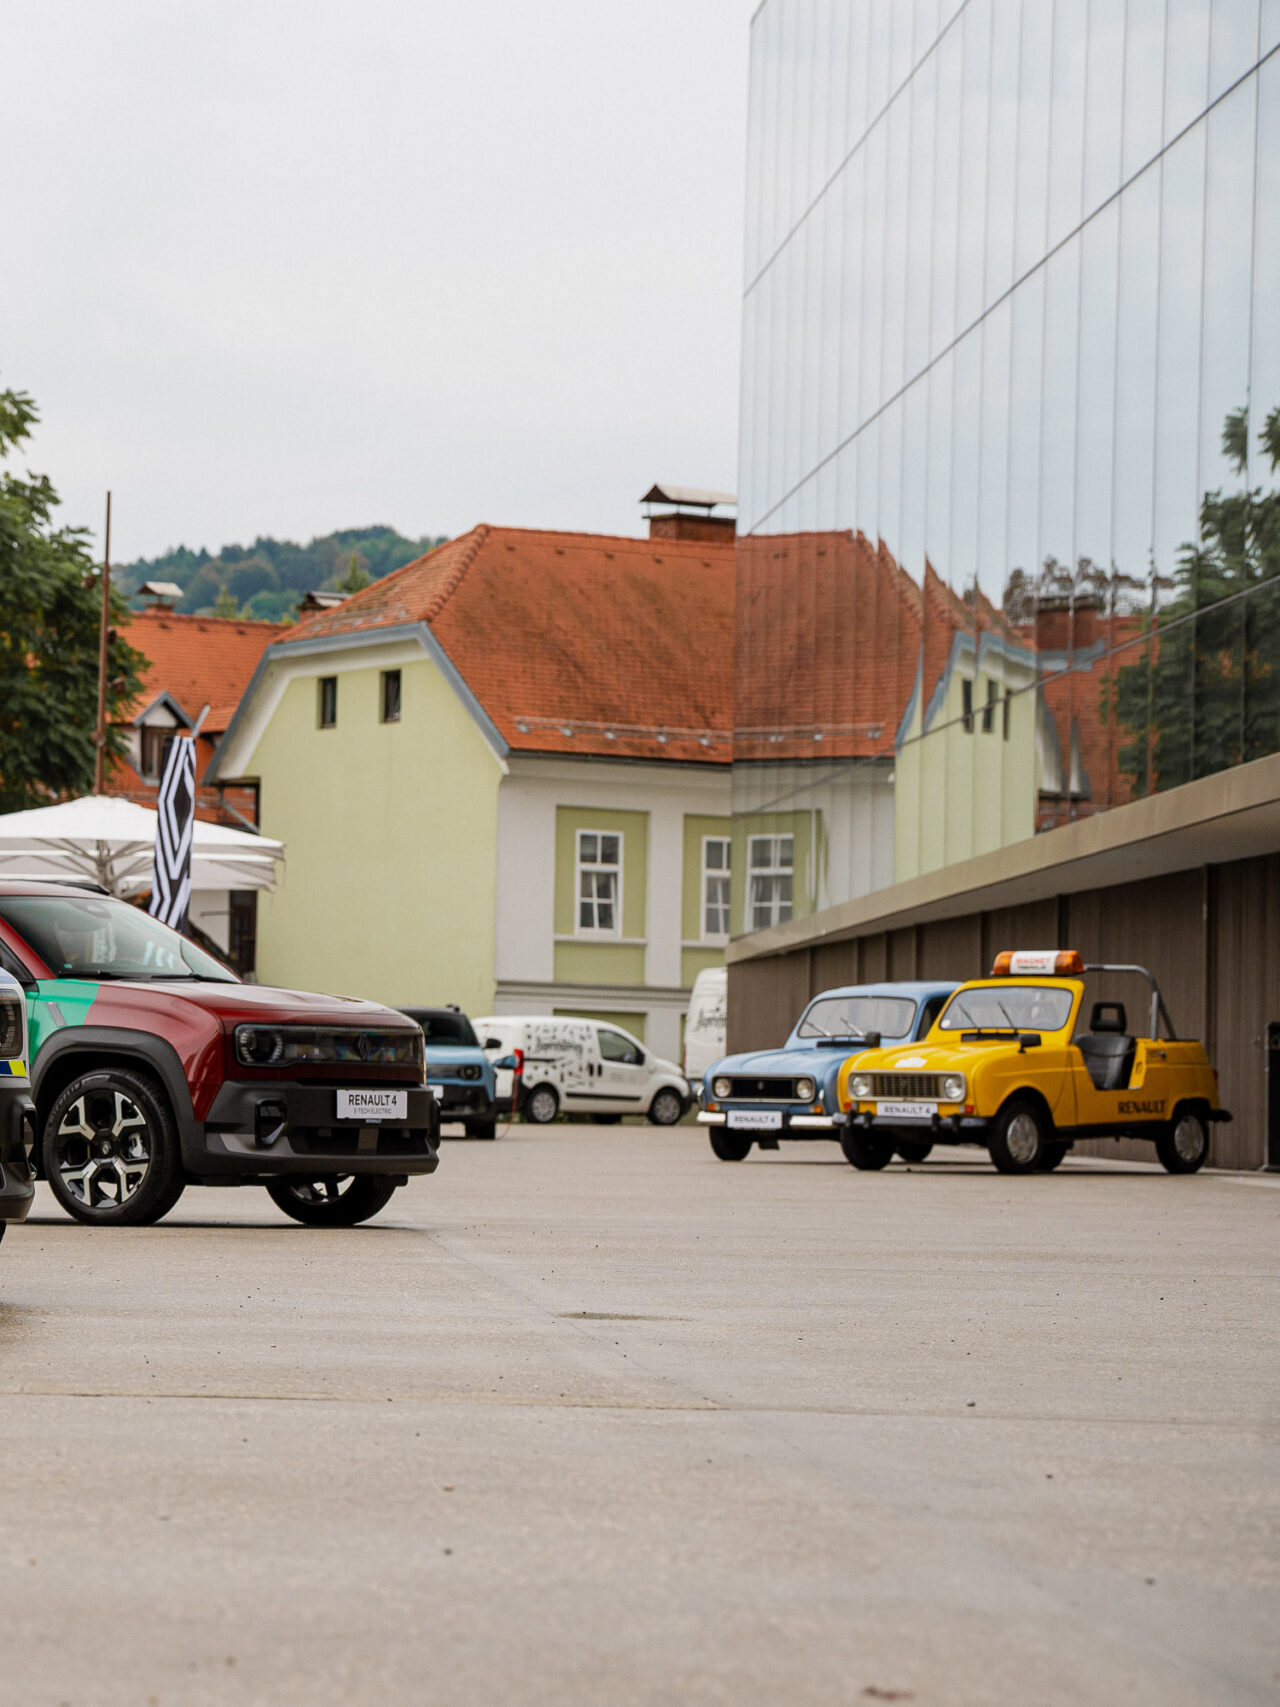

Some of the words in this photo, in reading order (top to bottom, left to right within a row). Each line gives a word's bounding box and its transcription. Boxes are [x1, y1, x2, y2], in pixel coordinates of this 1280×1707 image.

[348, 1094, 391, 1106] RENAULT
[391, 1095, 397, 1106] 4
[884, 1105, 923, 1114] RENAULT
[1118, 1100, 1167, 1115] RENAULT
